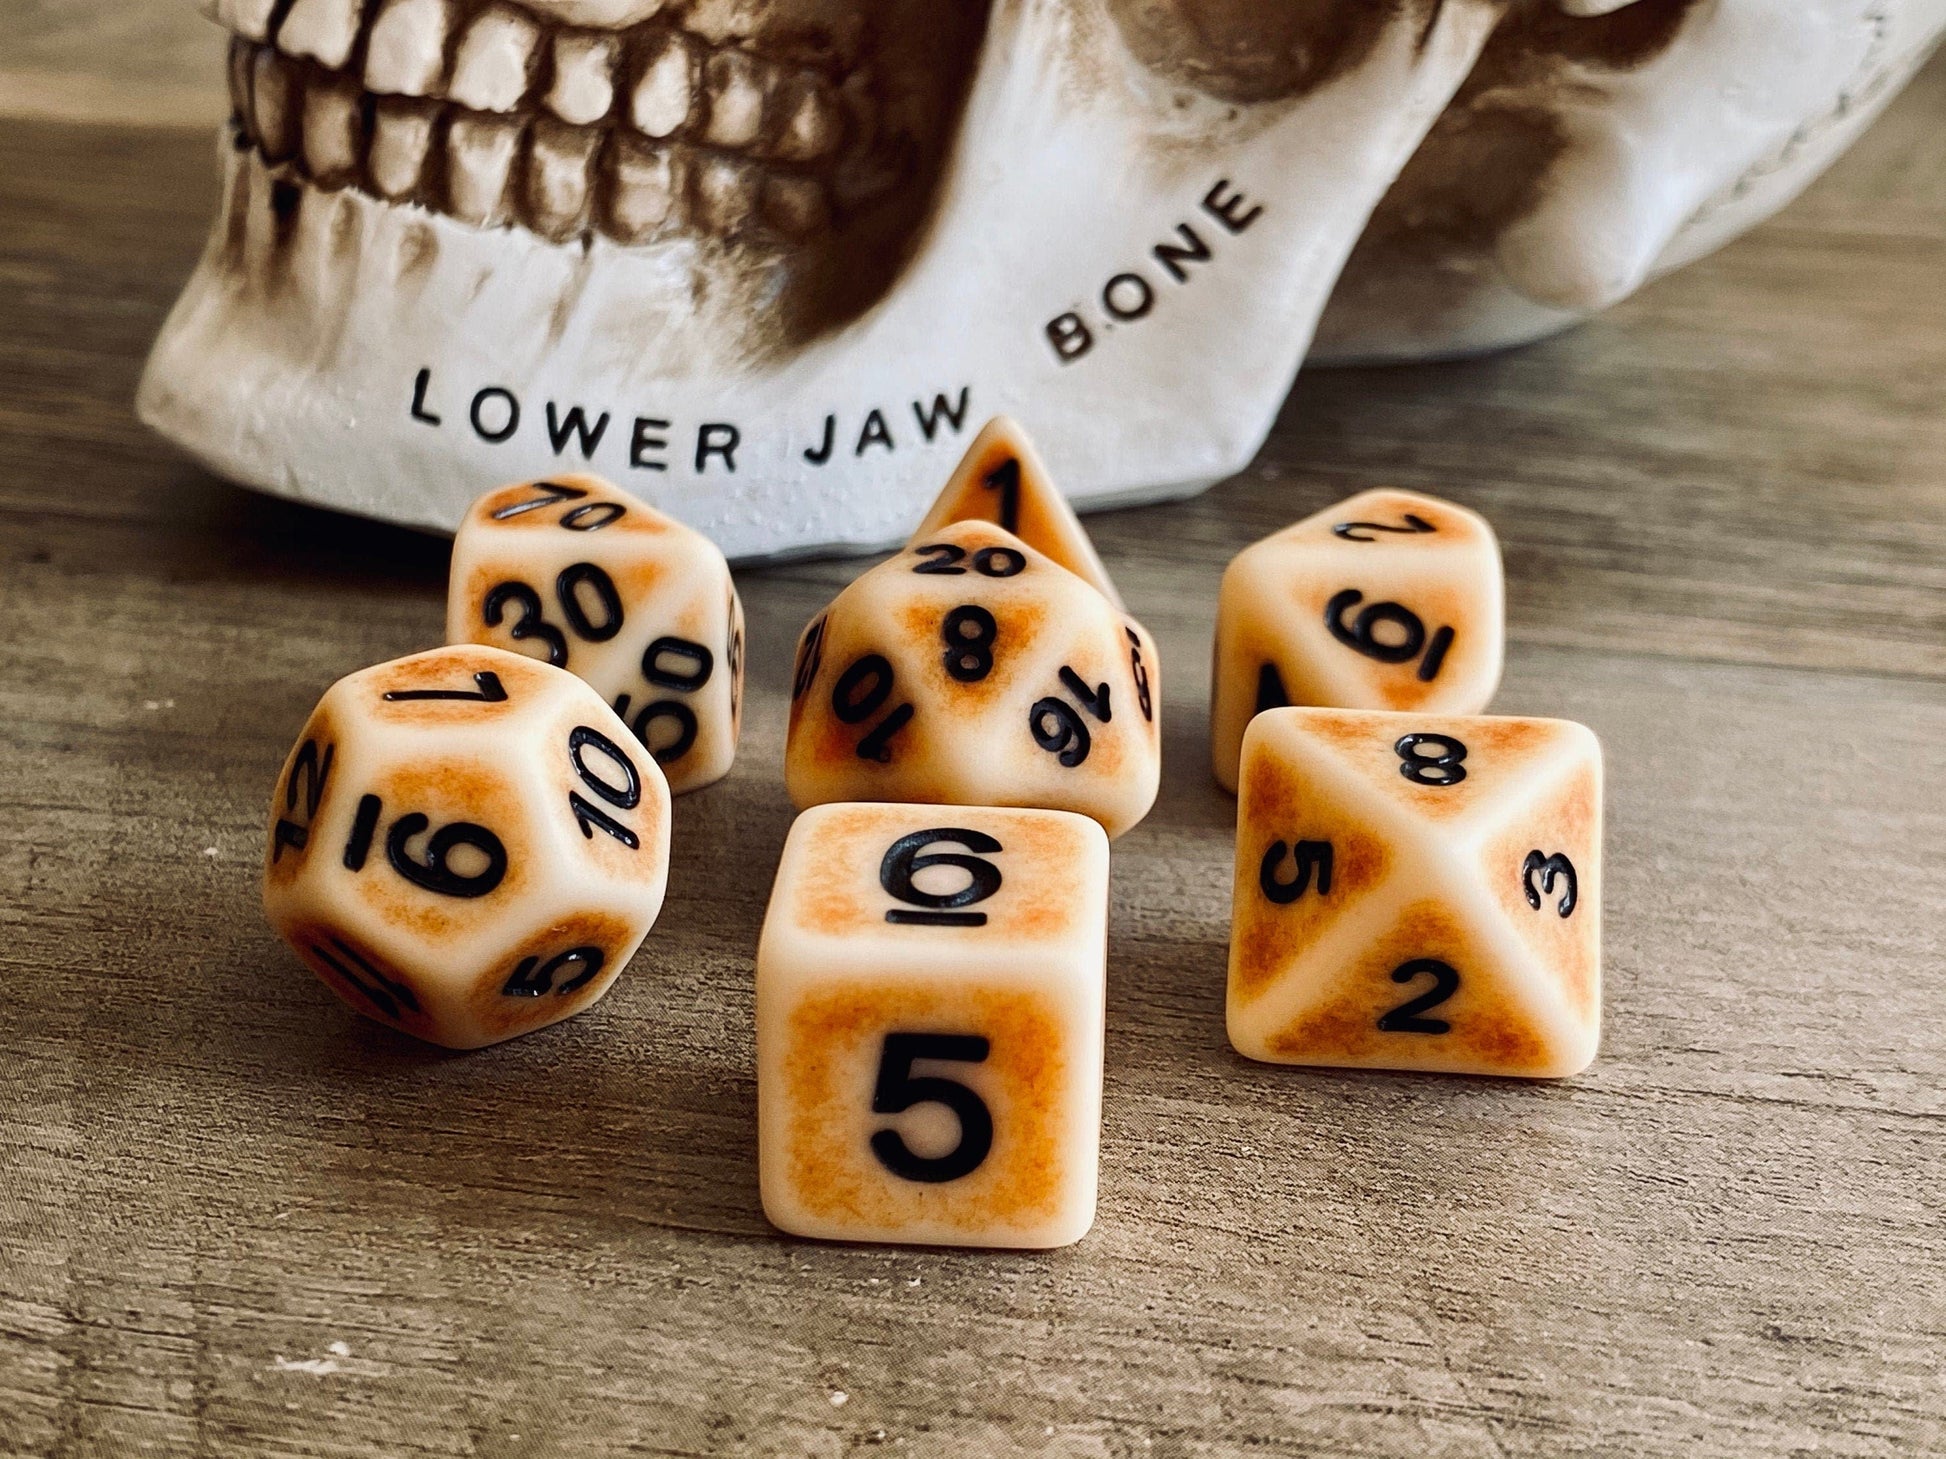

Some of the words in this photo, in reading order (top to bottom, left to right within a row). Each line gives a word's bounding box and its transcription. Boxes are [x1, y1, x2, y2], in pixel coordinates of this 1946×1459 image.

[409, 368, 741, 473] LOWER
[803, 386, 972, 466] JAW
[1044, 178, 1264, 365] BONE
[984, 458, 1020, 533] 1
[912, 543, 1027, 578] 20
[483, 562, 624, 668] 30
[943, 604, 998, 683] 8
[831, 653, 915, 764] 10
[1029, 664, 1113, 768] 16
[273, 738, 335, 865] 12
[568, 724, 642, 851] 10
[1393, 732, 1468, 787] 8
[879, 827, 1004, 927] 6
[1259, 839, 1333, 905] 5
[1522, 849, 1579, 919] 3
[501, 945, 605, 998] 5
[1376, 957, 1460, 1036] 2
[869, 1031, 995, 1185] 5
